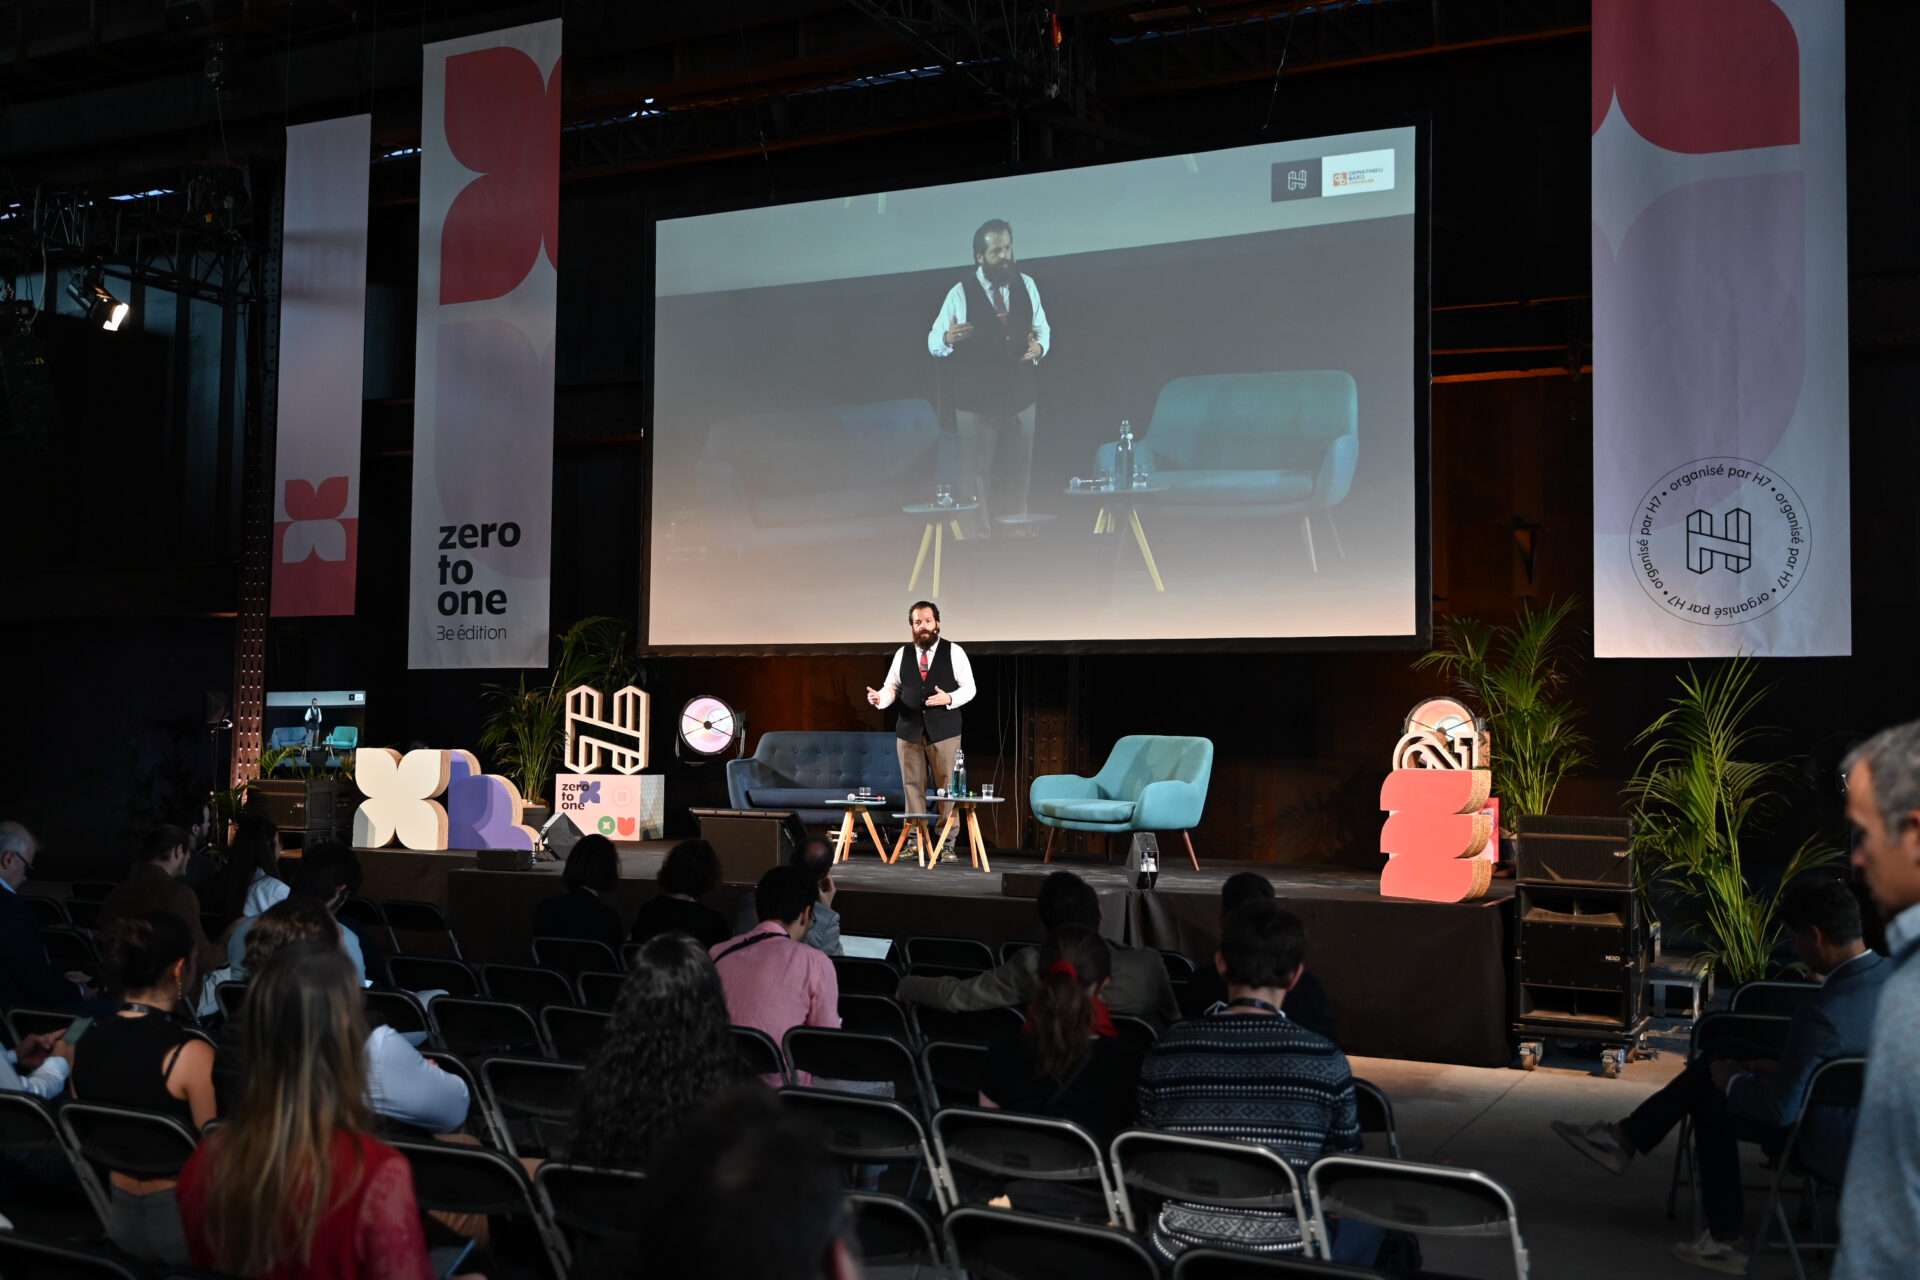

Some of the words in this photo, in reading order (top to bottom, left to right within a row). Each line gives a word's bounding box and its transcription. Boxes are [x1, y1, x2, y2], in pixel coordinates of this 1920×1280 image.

[1669, 463, 1725, 492] organisé
[1727, 466, 1752, 479] par
[1752, 472, 1773, 488] H7
[1646, 495, 1663, 514] H7
[1640, 512, 1653, 536] par
[1775, 492, 1805, 545] organisé
[438, 521, 521, 551] zero
[438, 554, 474, 585] to
[1636, 538, 1664, 590] organisé
[1785, 547, 1800, 572] par
[1777, 571, 1793, 590] H7
[437, 588, 508, 616] one
[1667, 594, 1687, 611] H7
[1686, 602, 1711, 616] par
[1713, 591, 1770, 619] organisé
[436, 625, 455, 641] 3e
[457, 623, 507, 640] édition
[561, 783, 590, 792] zero
[561, 791, 575, 802] to
[561, 801, 585, 810] one
